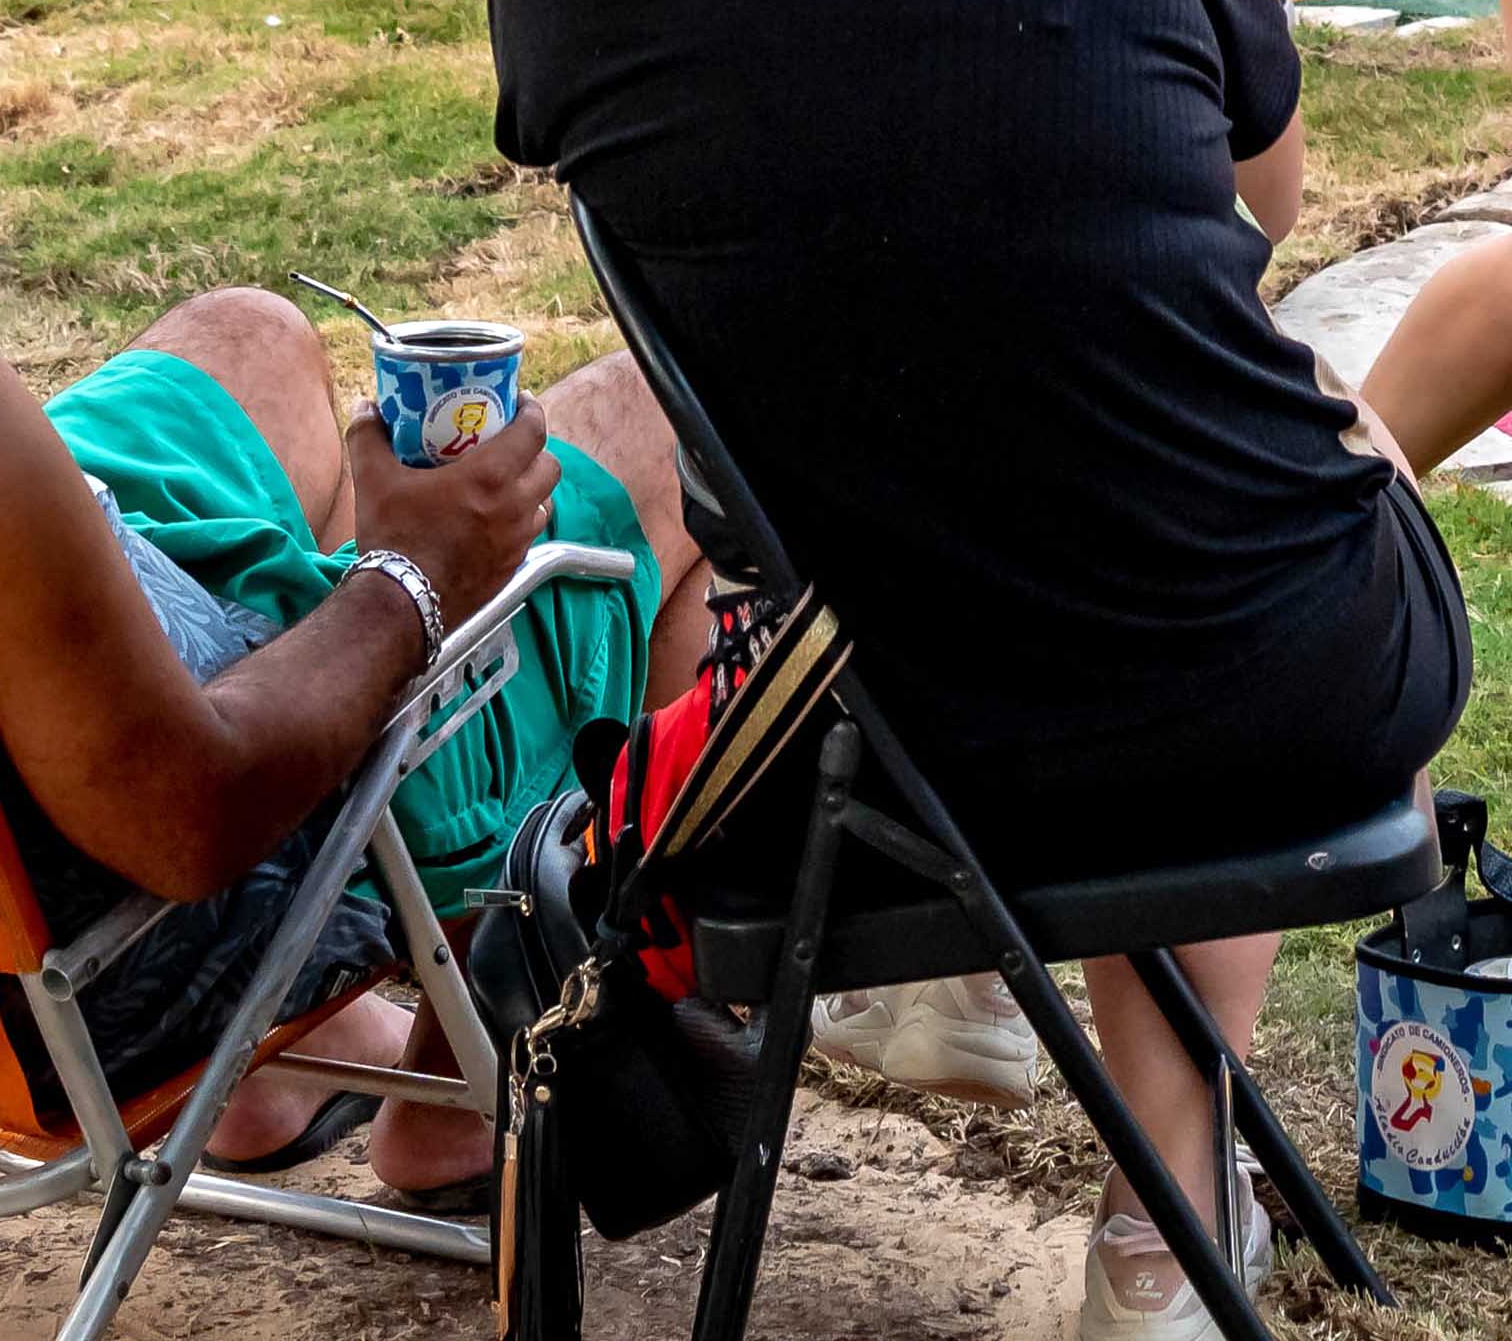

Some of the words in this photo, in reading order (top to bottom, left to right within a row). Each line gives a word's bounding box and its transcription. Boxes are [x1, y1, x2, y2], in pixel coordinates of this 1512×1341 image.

[1377, 1025, 1405, 1071] SINDICATO
[1409, 1025, 1421, 1037] DE
[1422, 1028, 1470, 1094] CAMIONEROS
